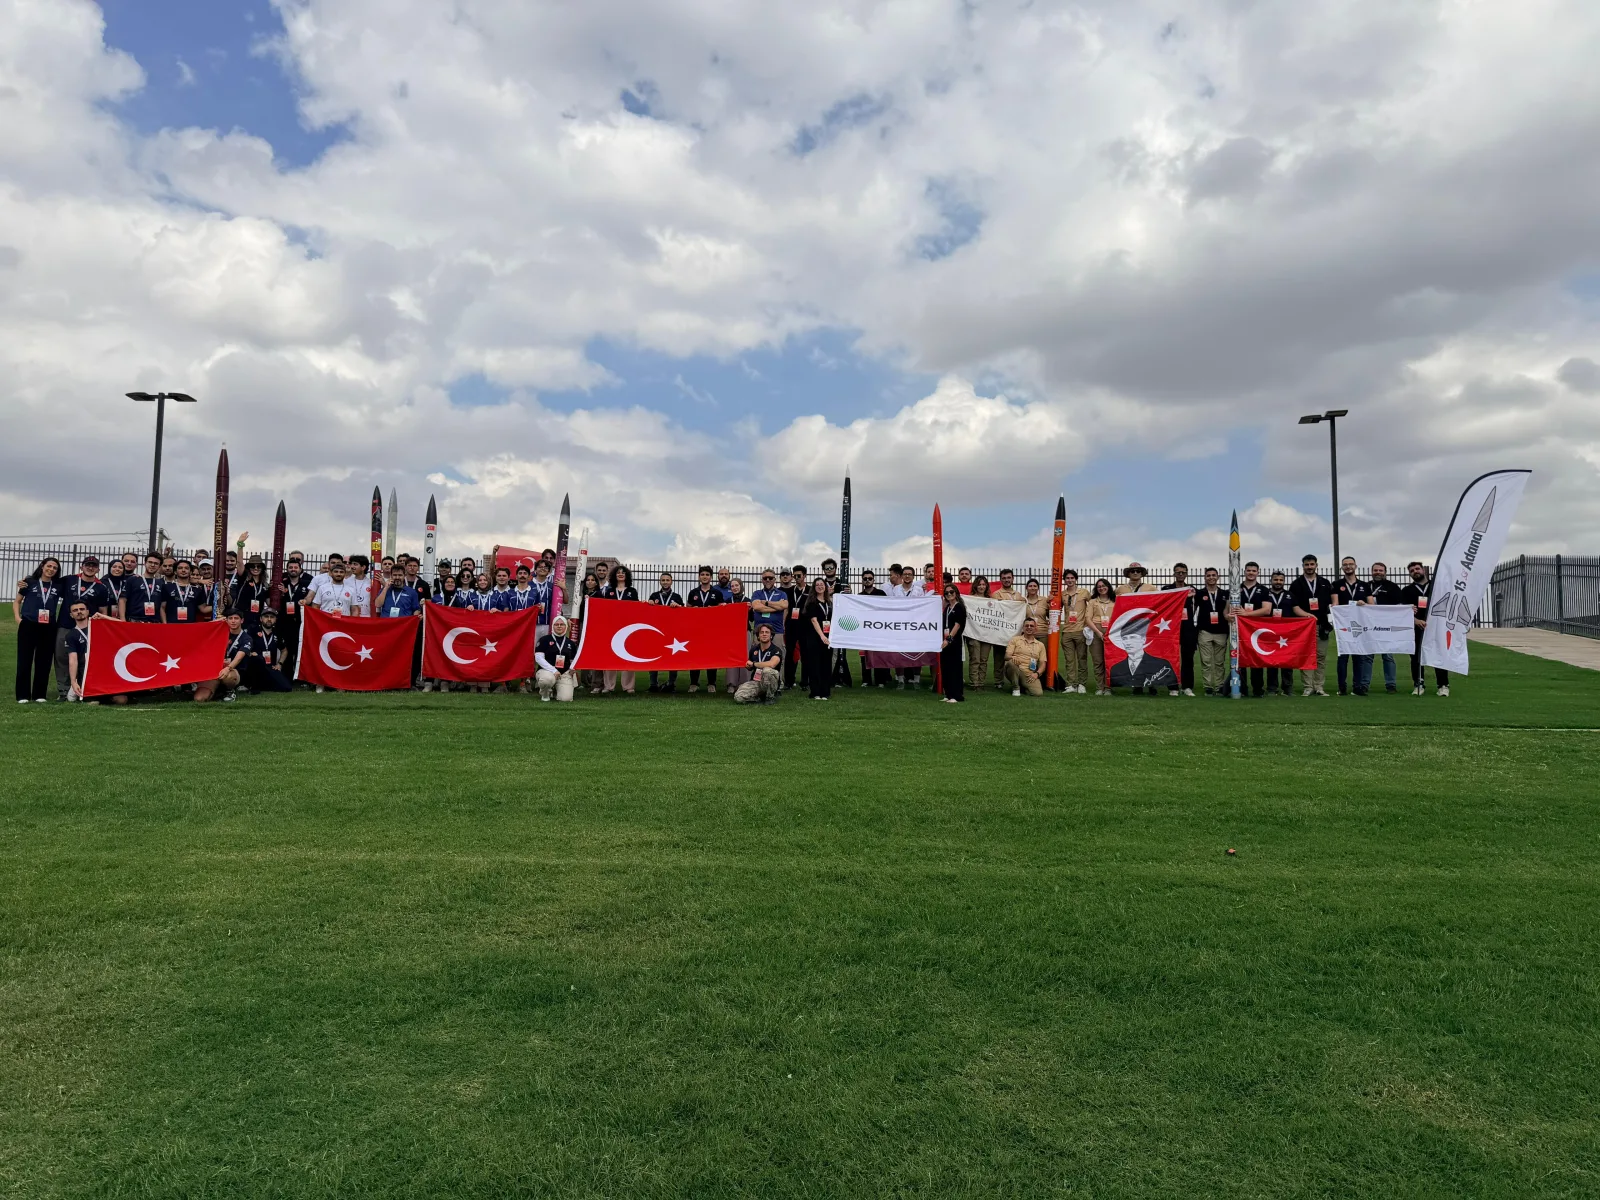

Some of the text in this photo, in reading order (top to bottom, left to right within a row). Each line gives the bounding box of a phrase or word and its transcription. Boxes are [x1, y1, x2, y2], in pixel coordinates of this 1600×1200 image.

[1460, 532, 1483, 571] Adana
[1051, 567, 1060, 597] ZENITH
[975, 606, 1005, 619] ATILIM
[863, 620, 938, 631] ROKETSAN
